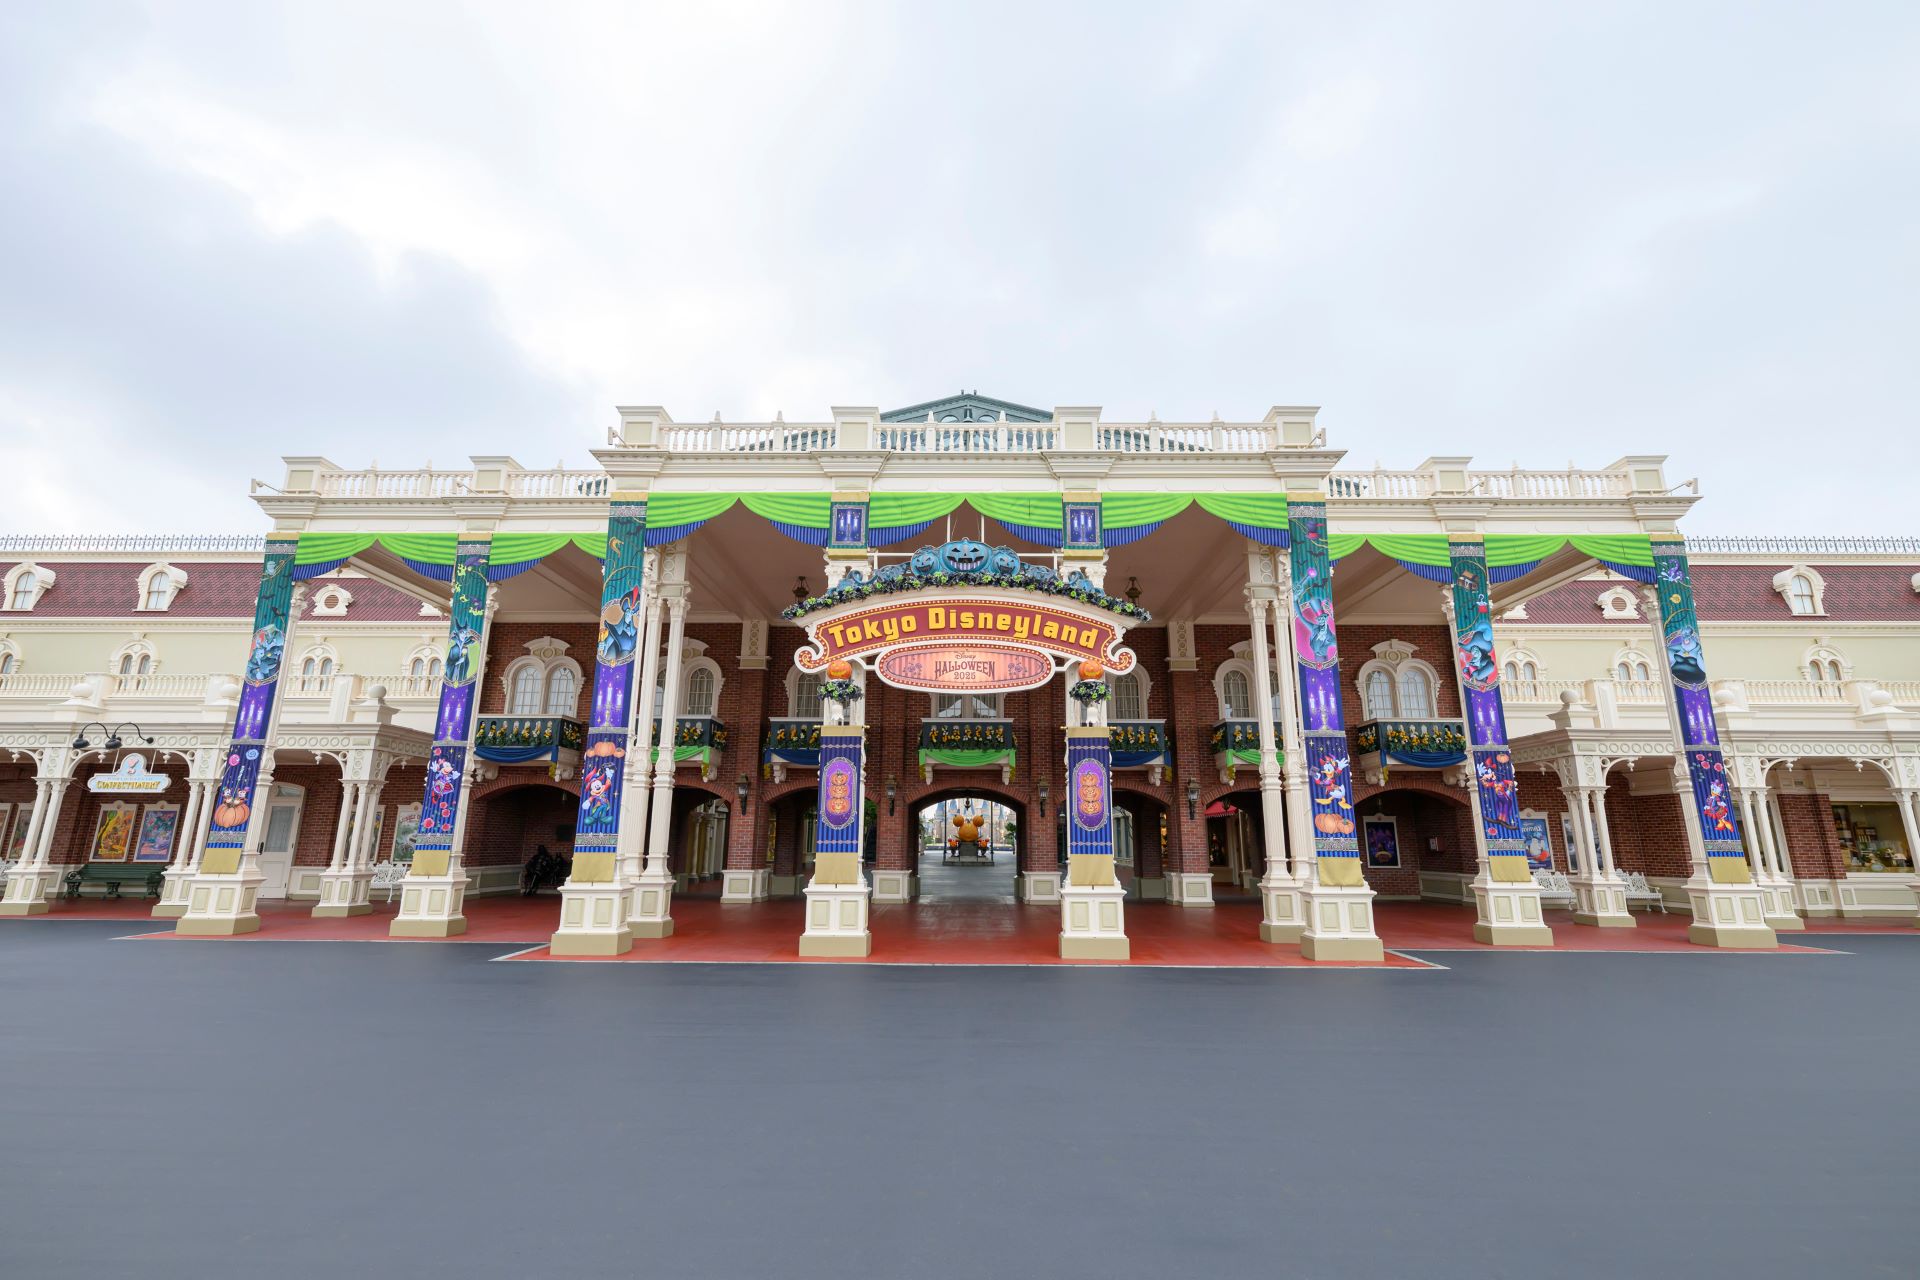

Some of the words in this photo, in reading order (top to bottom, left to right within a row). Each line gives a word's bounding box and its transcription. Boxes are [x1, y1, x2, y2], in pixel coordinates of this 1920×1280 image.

[828, 614, 917, 648] Tokyo
[928, 607, 1099, 649] Disneyland
[955, 652, 976, 660] Disney
[935, 661, 995, 680] HALLOWEEN
[954, 672, 976, 680] 2025
